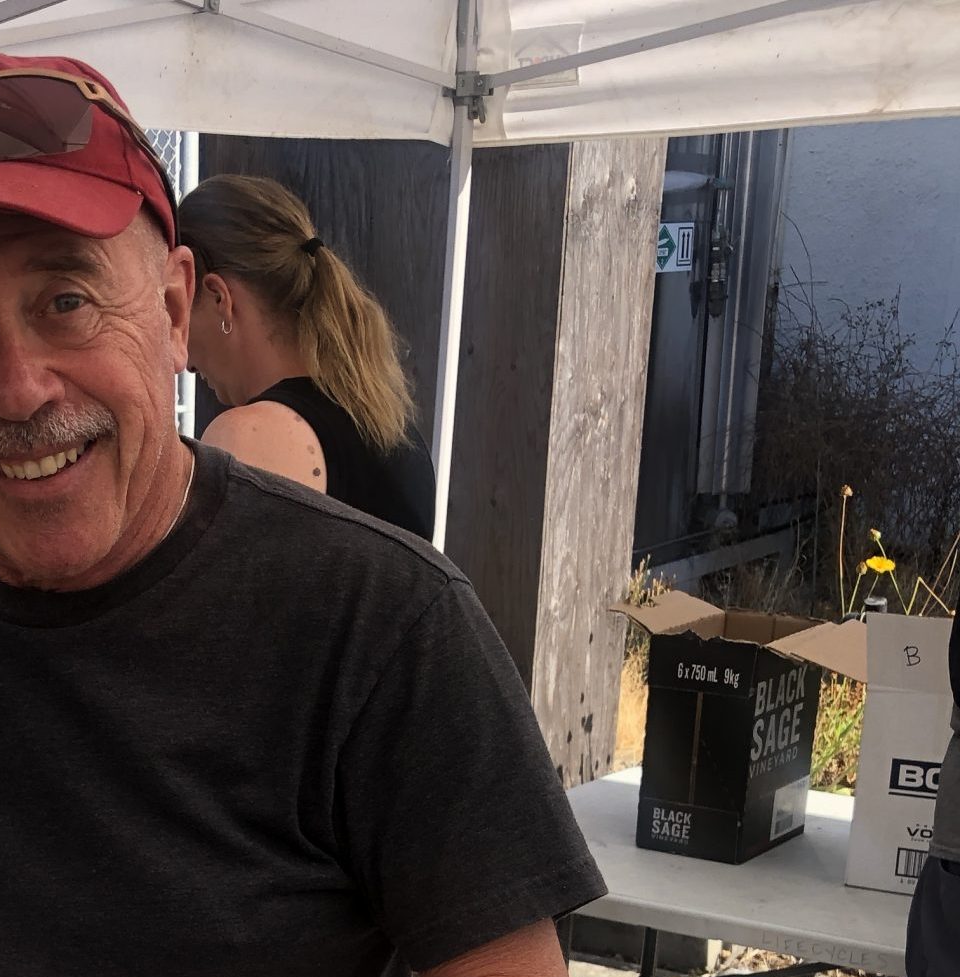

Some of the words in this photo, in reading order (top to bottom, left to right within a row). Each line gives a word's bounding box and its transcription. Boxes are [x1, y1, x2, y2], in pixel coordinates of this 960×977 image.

[903, 645, 921, 667] B
[677, 662, 684, 679] 6
[684, 667, 690, 680] x
[690, 663, 707, 681] 750
[706, 666, 718, 683] mL
[723, 667, 740, 689] 9kg
[754, 663, 809, 717] BLACK
[750, 702, 804, 761] SAGE
[749, 746, 798, 779] VINEYARD
[651, 819, 691, 840] SAGE
[652, 807, 692, 825] BLACK
